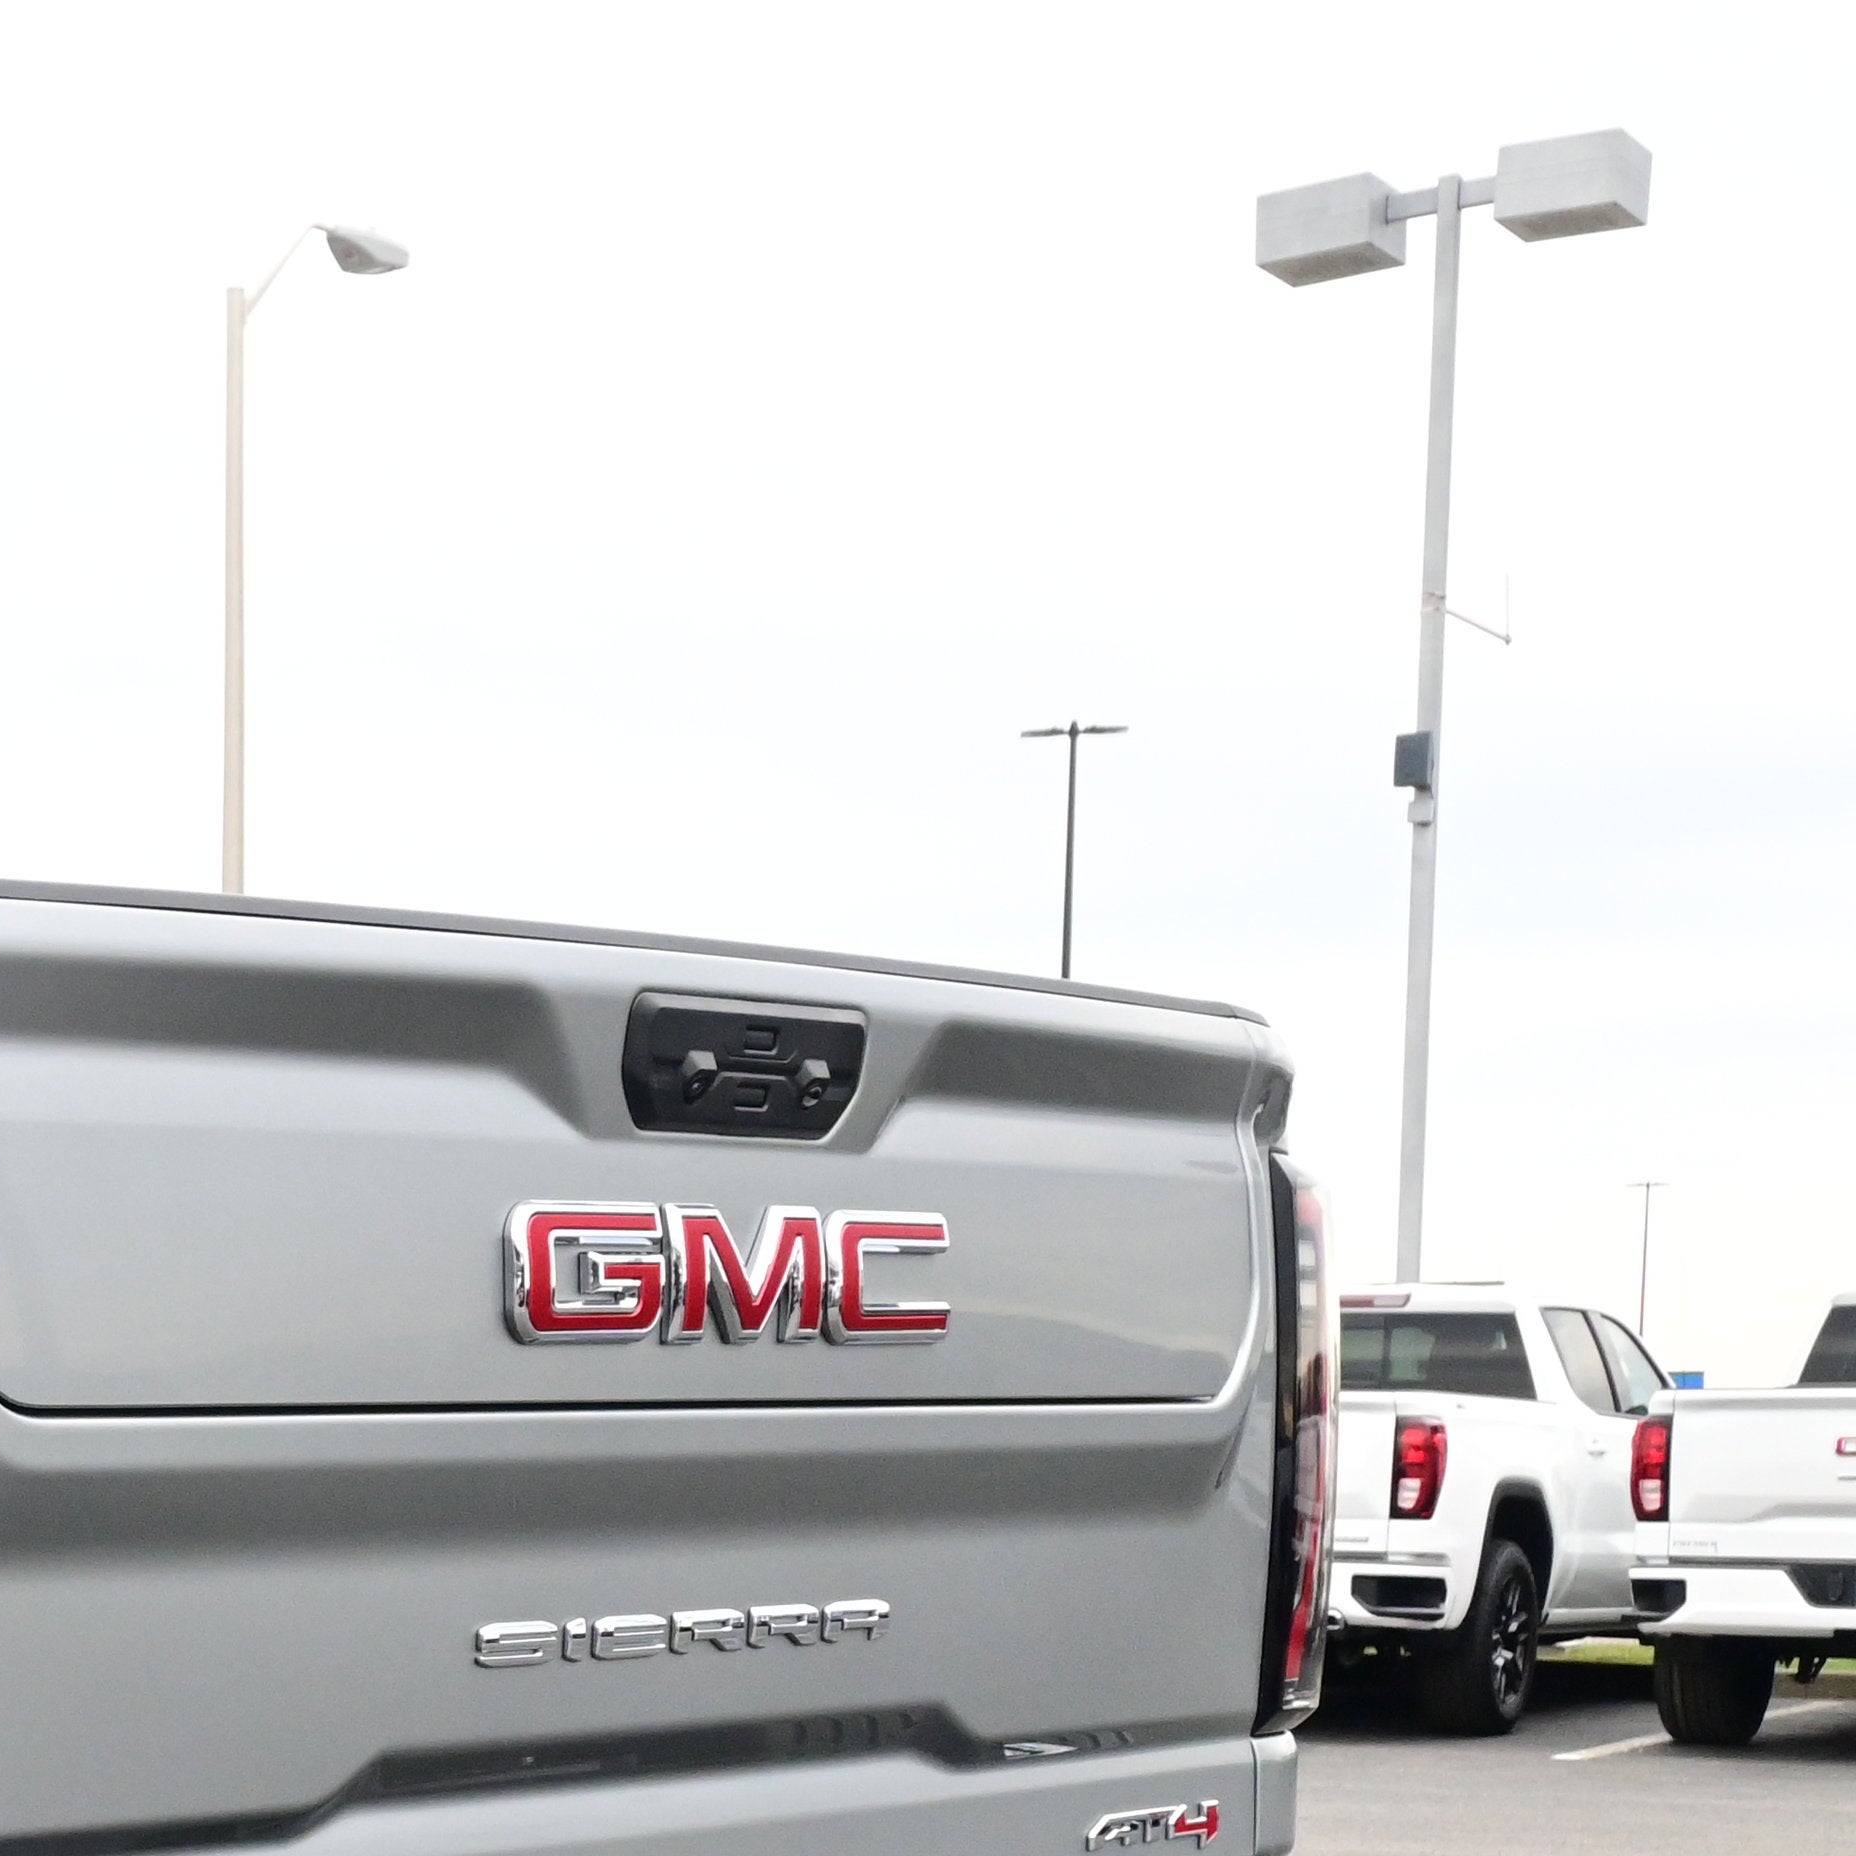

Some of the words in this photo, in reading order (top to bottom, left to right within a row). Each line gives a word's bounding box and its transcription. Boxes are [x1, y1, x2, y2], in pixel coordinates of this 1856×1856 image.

[503, 1200, 952, 1346] GMC
[475, 1598, 890, 1668] SIERRA
[1086, 1799, 1220, 1851] AT4
